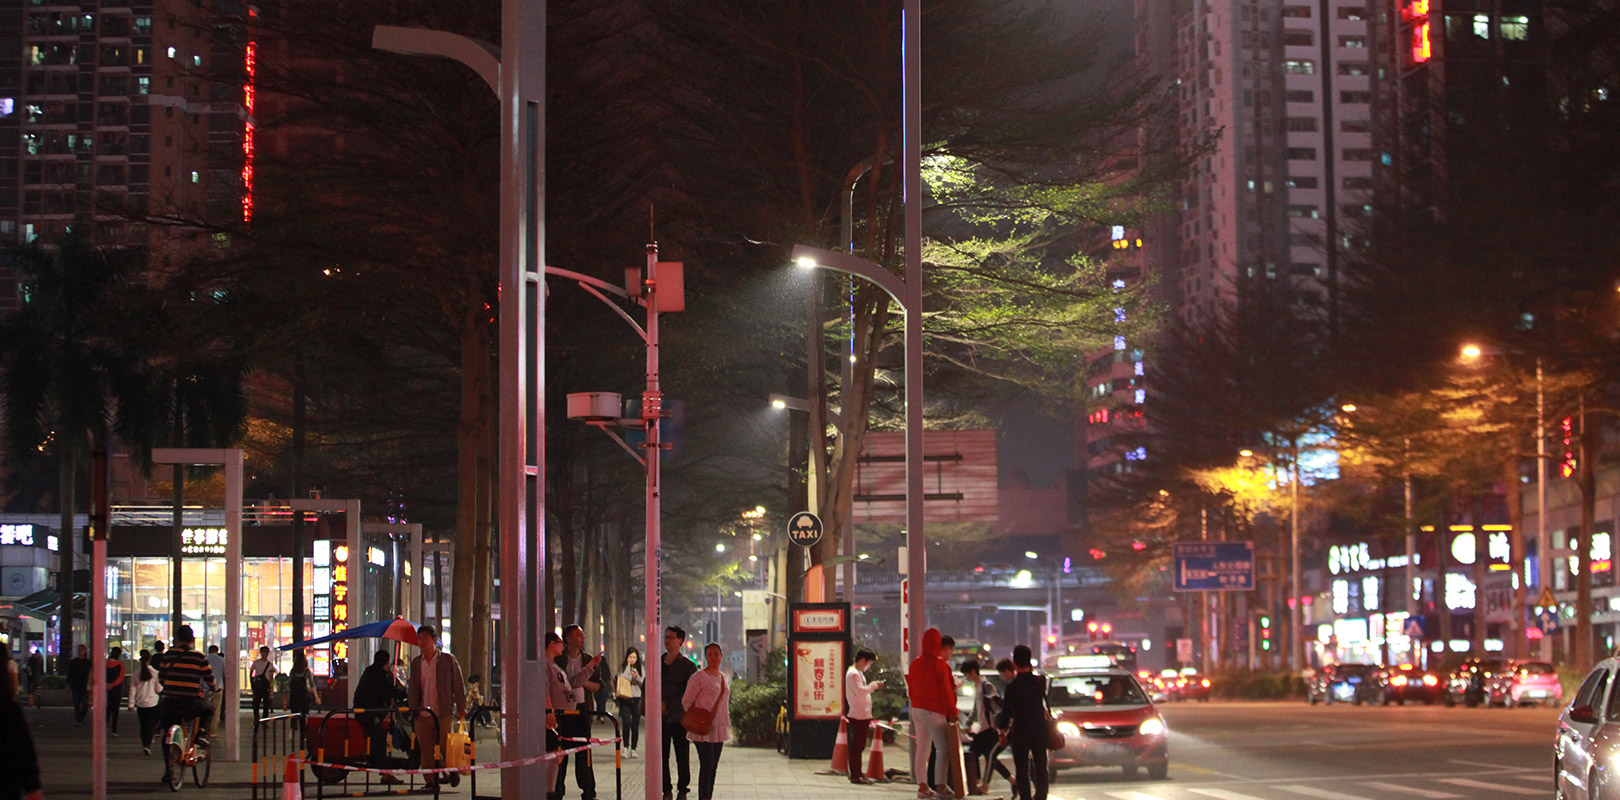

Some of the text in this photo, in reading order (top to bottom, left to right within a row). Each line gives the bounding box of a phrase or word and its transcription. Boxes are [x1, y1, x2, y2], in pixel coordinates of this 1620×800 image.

[791, 530, 818, 539] TAXI
[813, 658, 824, 700] 新春快乐
